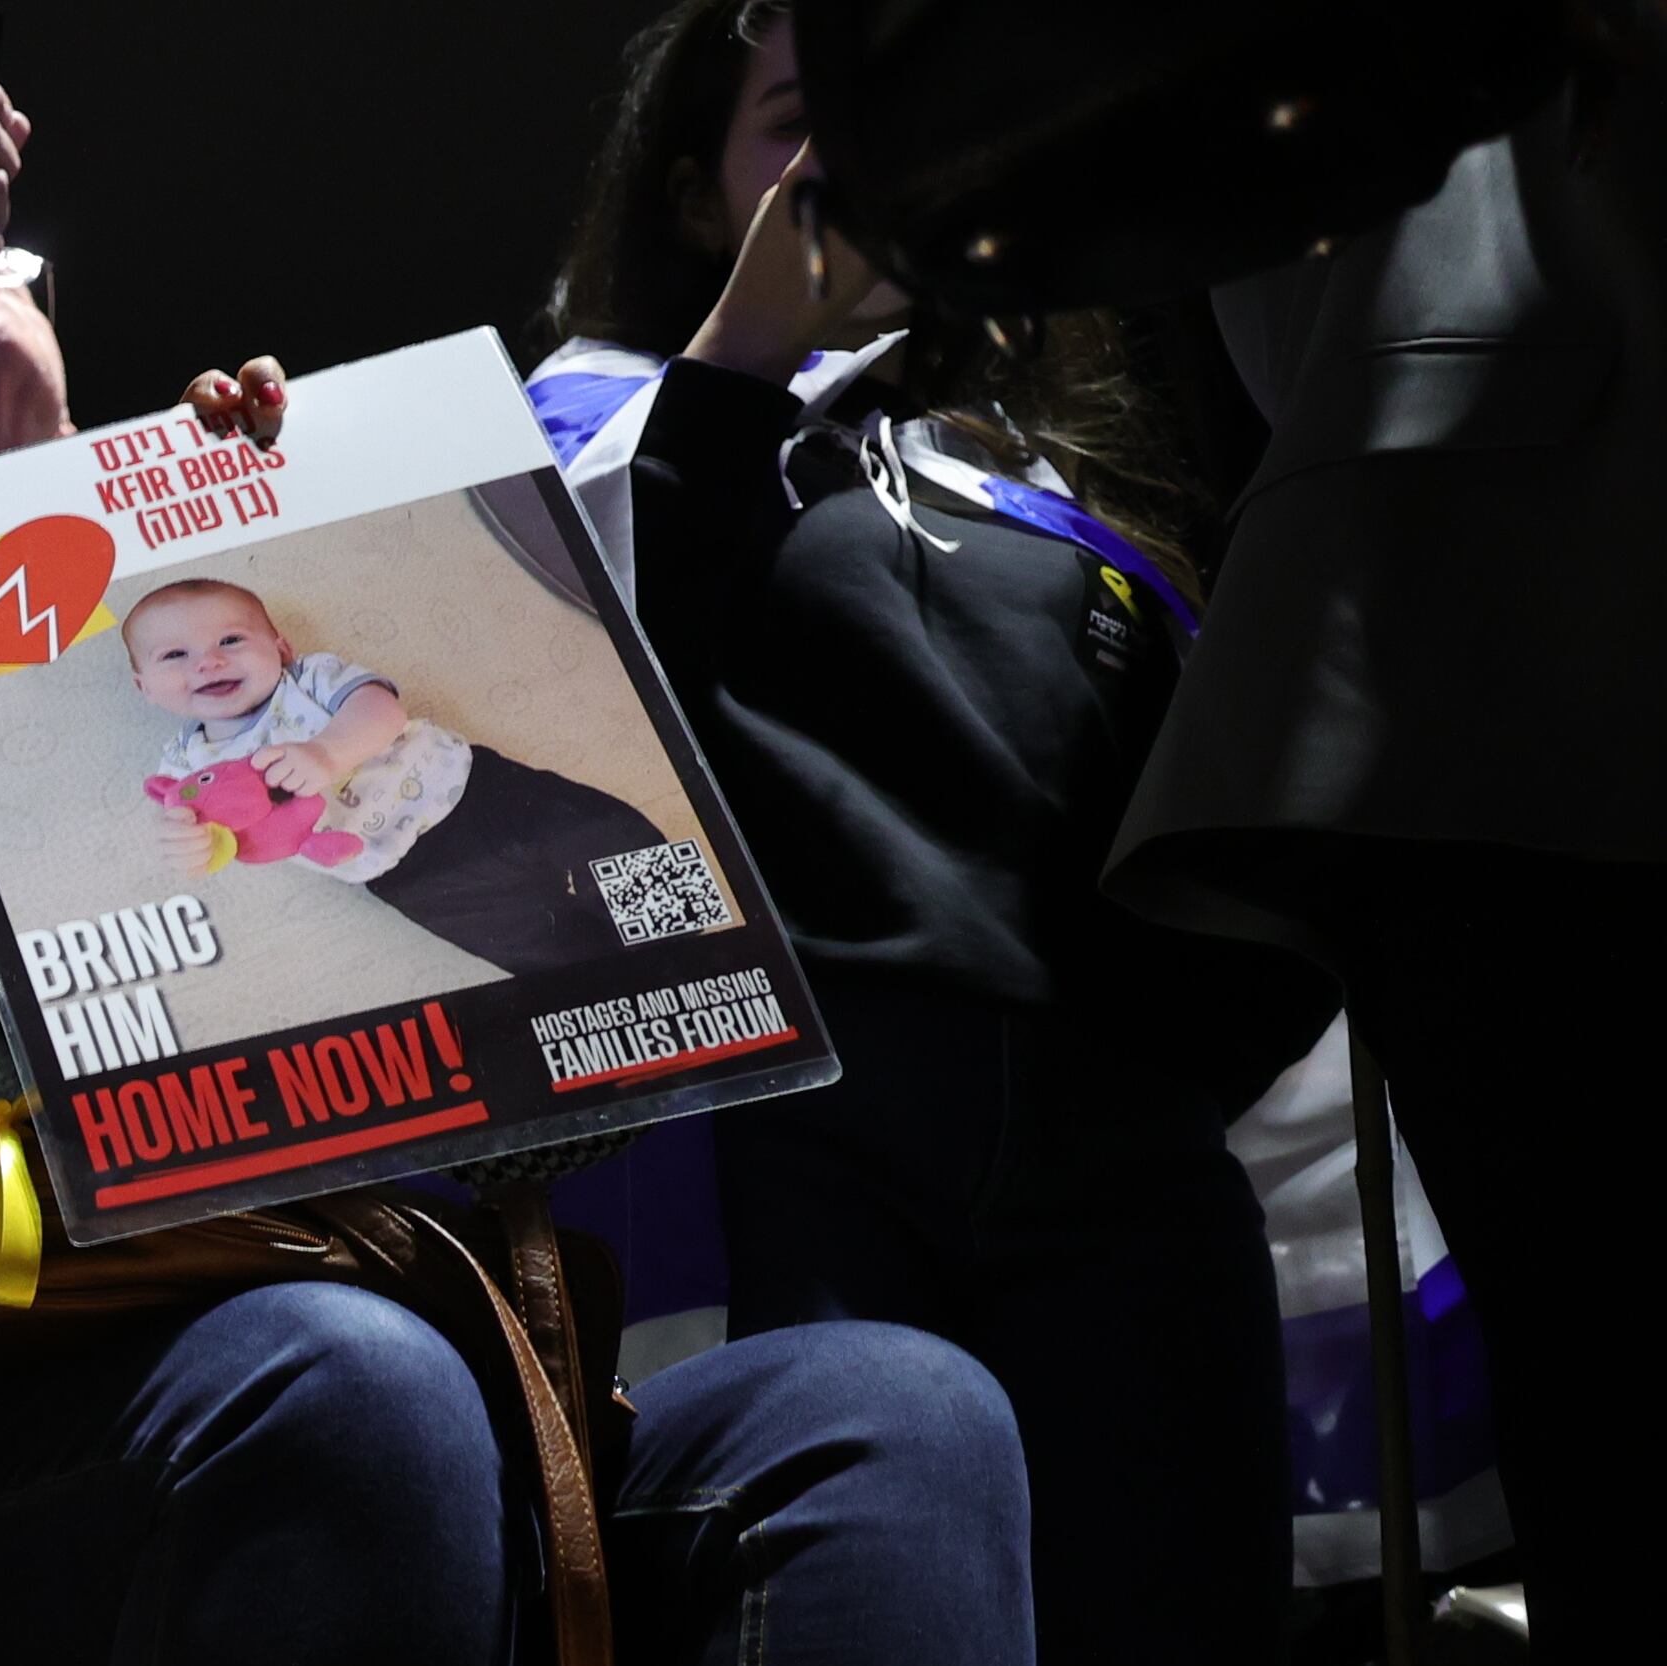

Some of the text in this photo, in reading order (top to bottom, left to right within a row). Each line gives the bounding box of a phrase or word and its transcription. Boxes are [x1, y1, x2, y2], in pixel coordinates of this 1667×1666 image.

[90, 425, 175, 472] ביבס
[95, 442, 285, 514] KFIR BIBAS
[136, 478, 279, 550] (בן שנה)
[17, 895, 220, 1002] BRING
[43, 984, 181, 1080] HIM
[531, 967, 772, 1044] HOSTAGES AND MISSING
[542, 995, 789, 1083] FAMILIES FORUM
[72, 1001, 473, 1173] HOME NOW!
